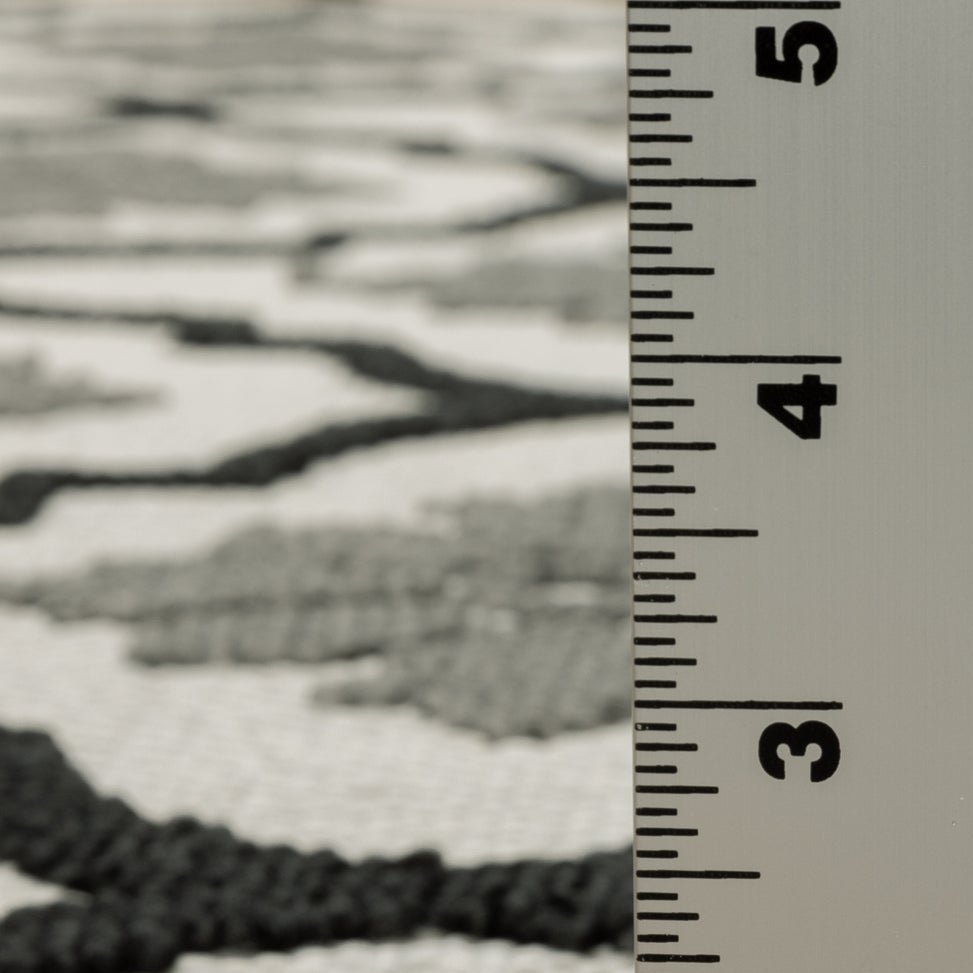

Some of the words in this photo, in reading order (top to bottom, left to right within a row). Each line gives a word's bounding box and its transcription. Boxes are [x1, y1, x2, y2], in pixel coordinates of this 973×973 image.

[755, 20, 839, 87] 5
[756, 373, 838, 441] 4
[758, 719, 842, 783] 3
